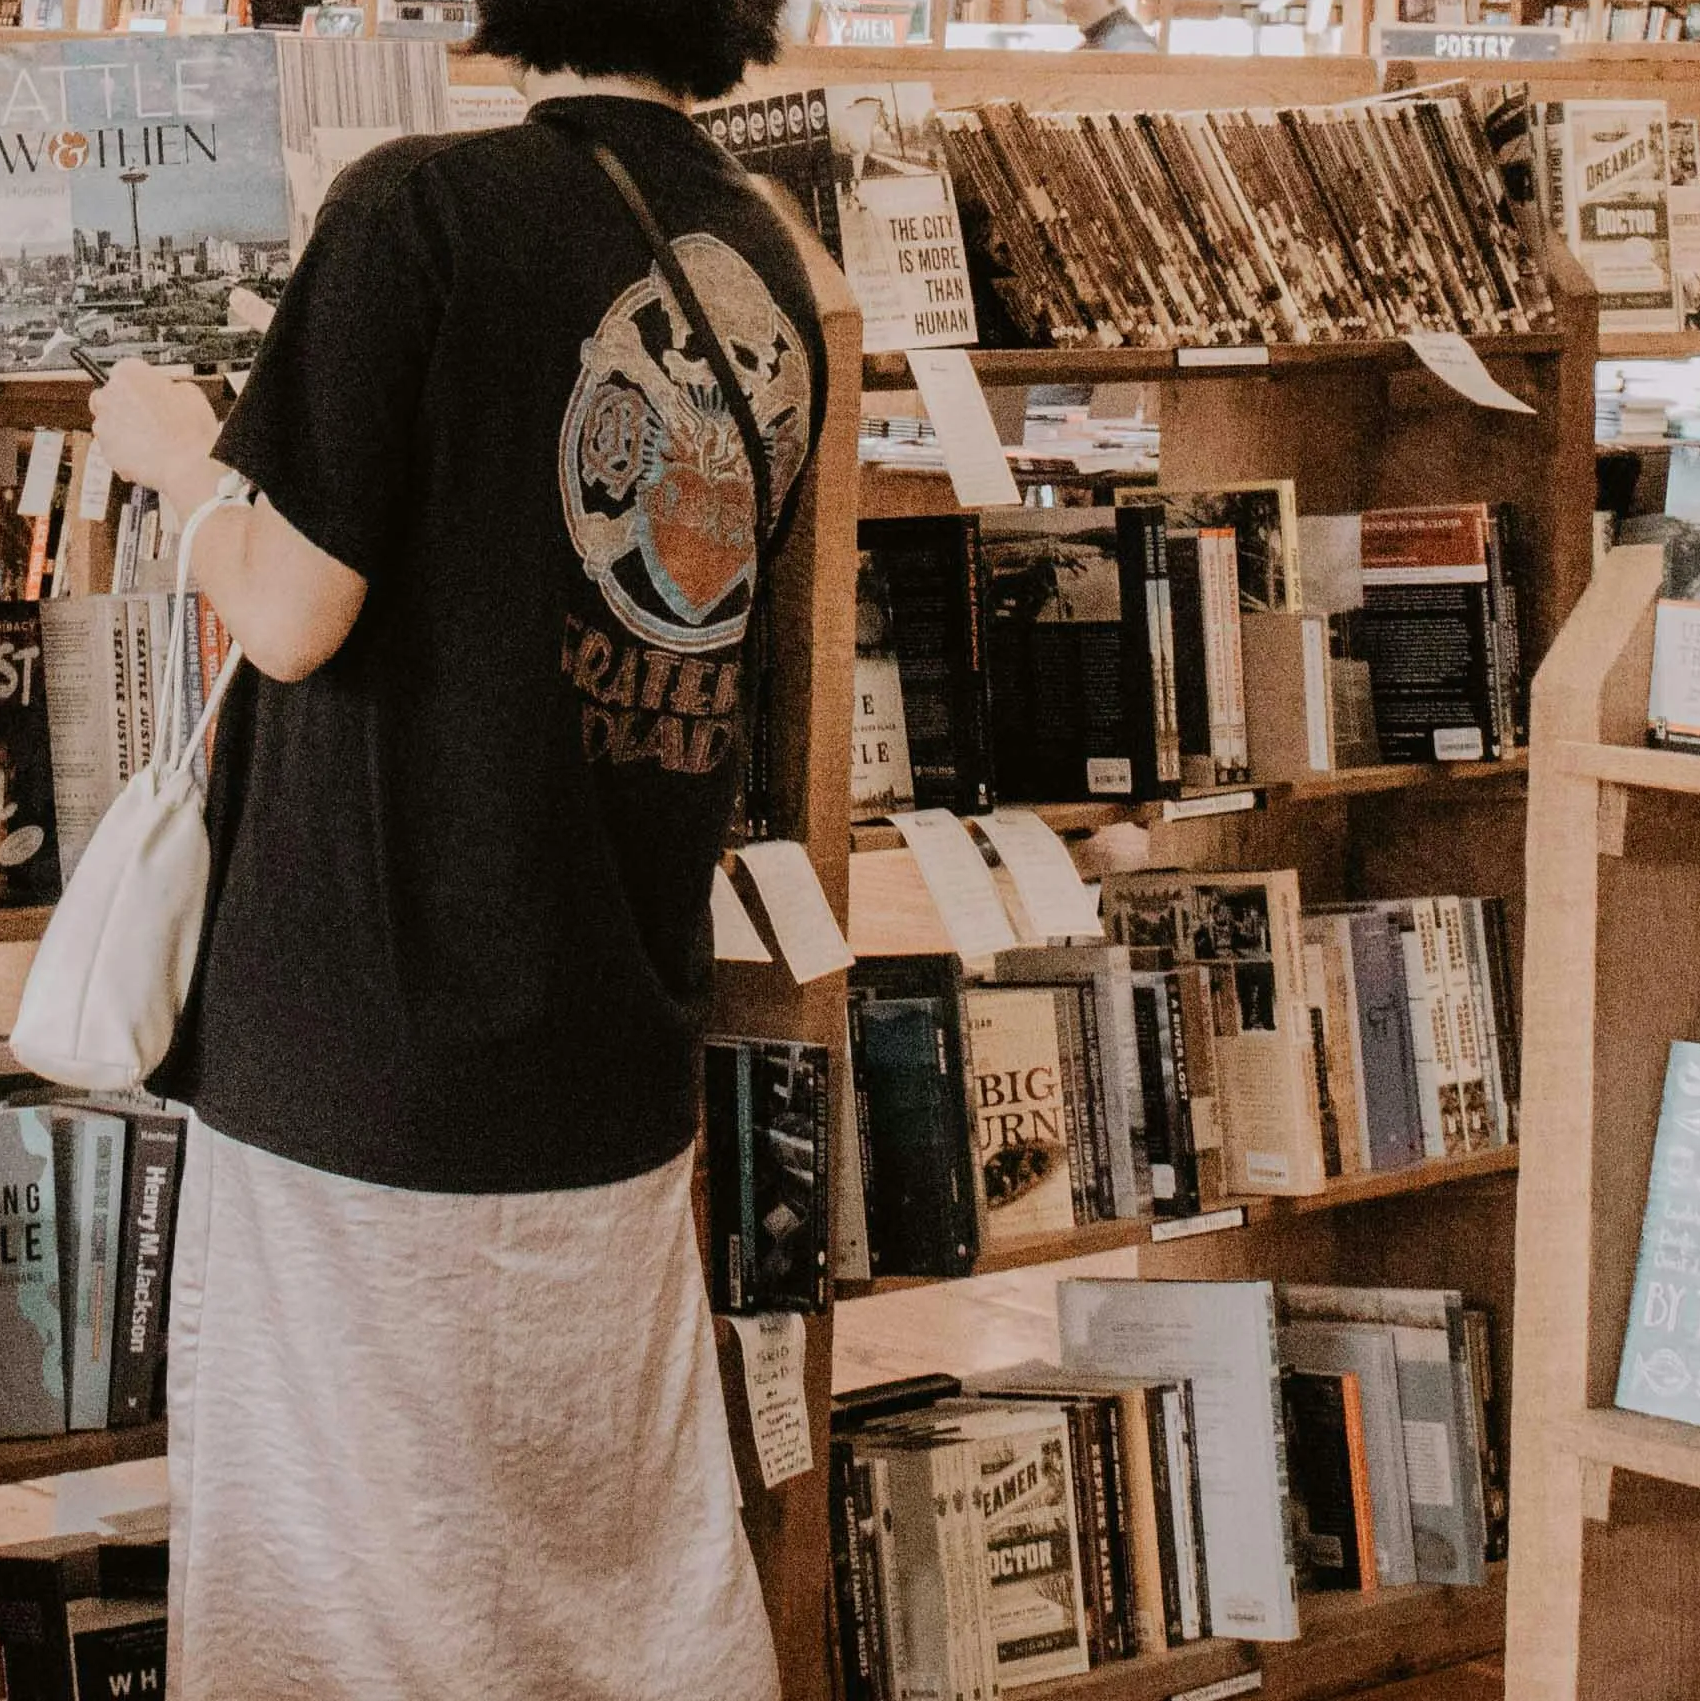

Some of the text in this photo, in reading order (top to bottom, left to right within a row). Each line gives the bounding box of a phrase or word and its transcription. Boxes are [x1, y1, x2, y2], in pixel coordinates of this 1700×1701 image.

[1435, 34, 1514, 58] POETRY
[89, 123, 218, 169] THEN
[1585, 139, 1647, 192] DREAMER
[890, 215, 957, 242] THE CITY
[1596, 207, 1657, 236] DOCTOR
[899, 246, 962, 274] IS MORE
[925, 280, 965, 305] THAN
[915, 309, 970, 335] HUMAN
[184, 596, 200, 674] NOWHERE
[206, 610, 218, 647] HIGH
[136, 627, 149, 701] SEATTLE
[113, 627, 129, 782] SEATTLE JUSTICE
[1172, 1013, 1184, 1058] RIVER
[975, 1066, 1059, 1108] BIG
[1176, 1061, 1188, 1101] LOST
[140, 1129, 178, 1144] Kaufman
[980, 1108, 1062, 1151] URN
[130, 1165, 167, 1354] Henry M. Jackson
[1644, 1282, 1687, 1333] BY
[983, 1461, 1039, 1519] EAMER
[1090, 1443, 1114, 1614] EMPIRE MAKER
[989, 1540, 1052, 1577] OCTOR
[844, 1496, 869, 1677] CAPITALIST FAMILY VALUES
